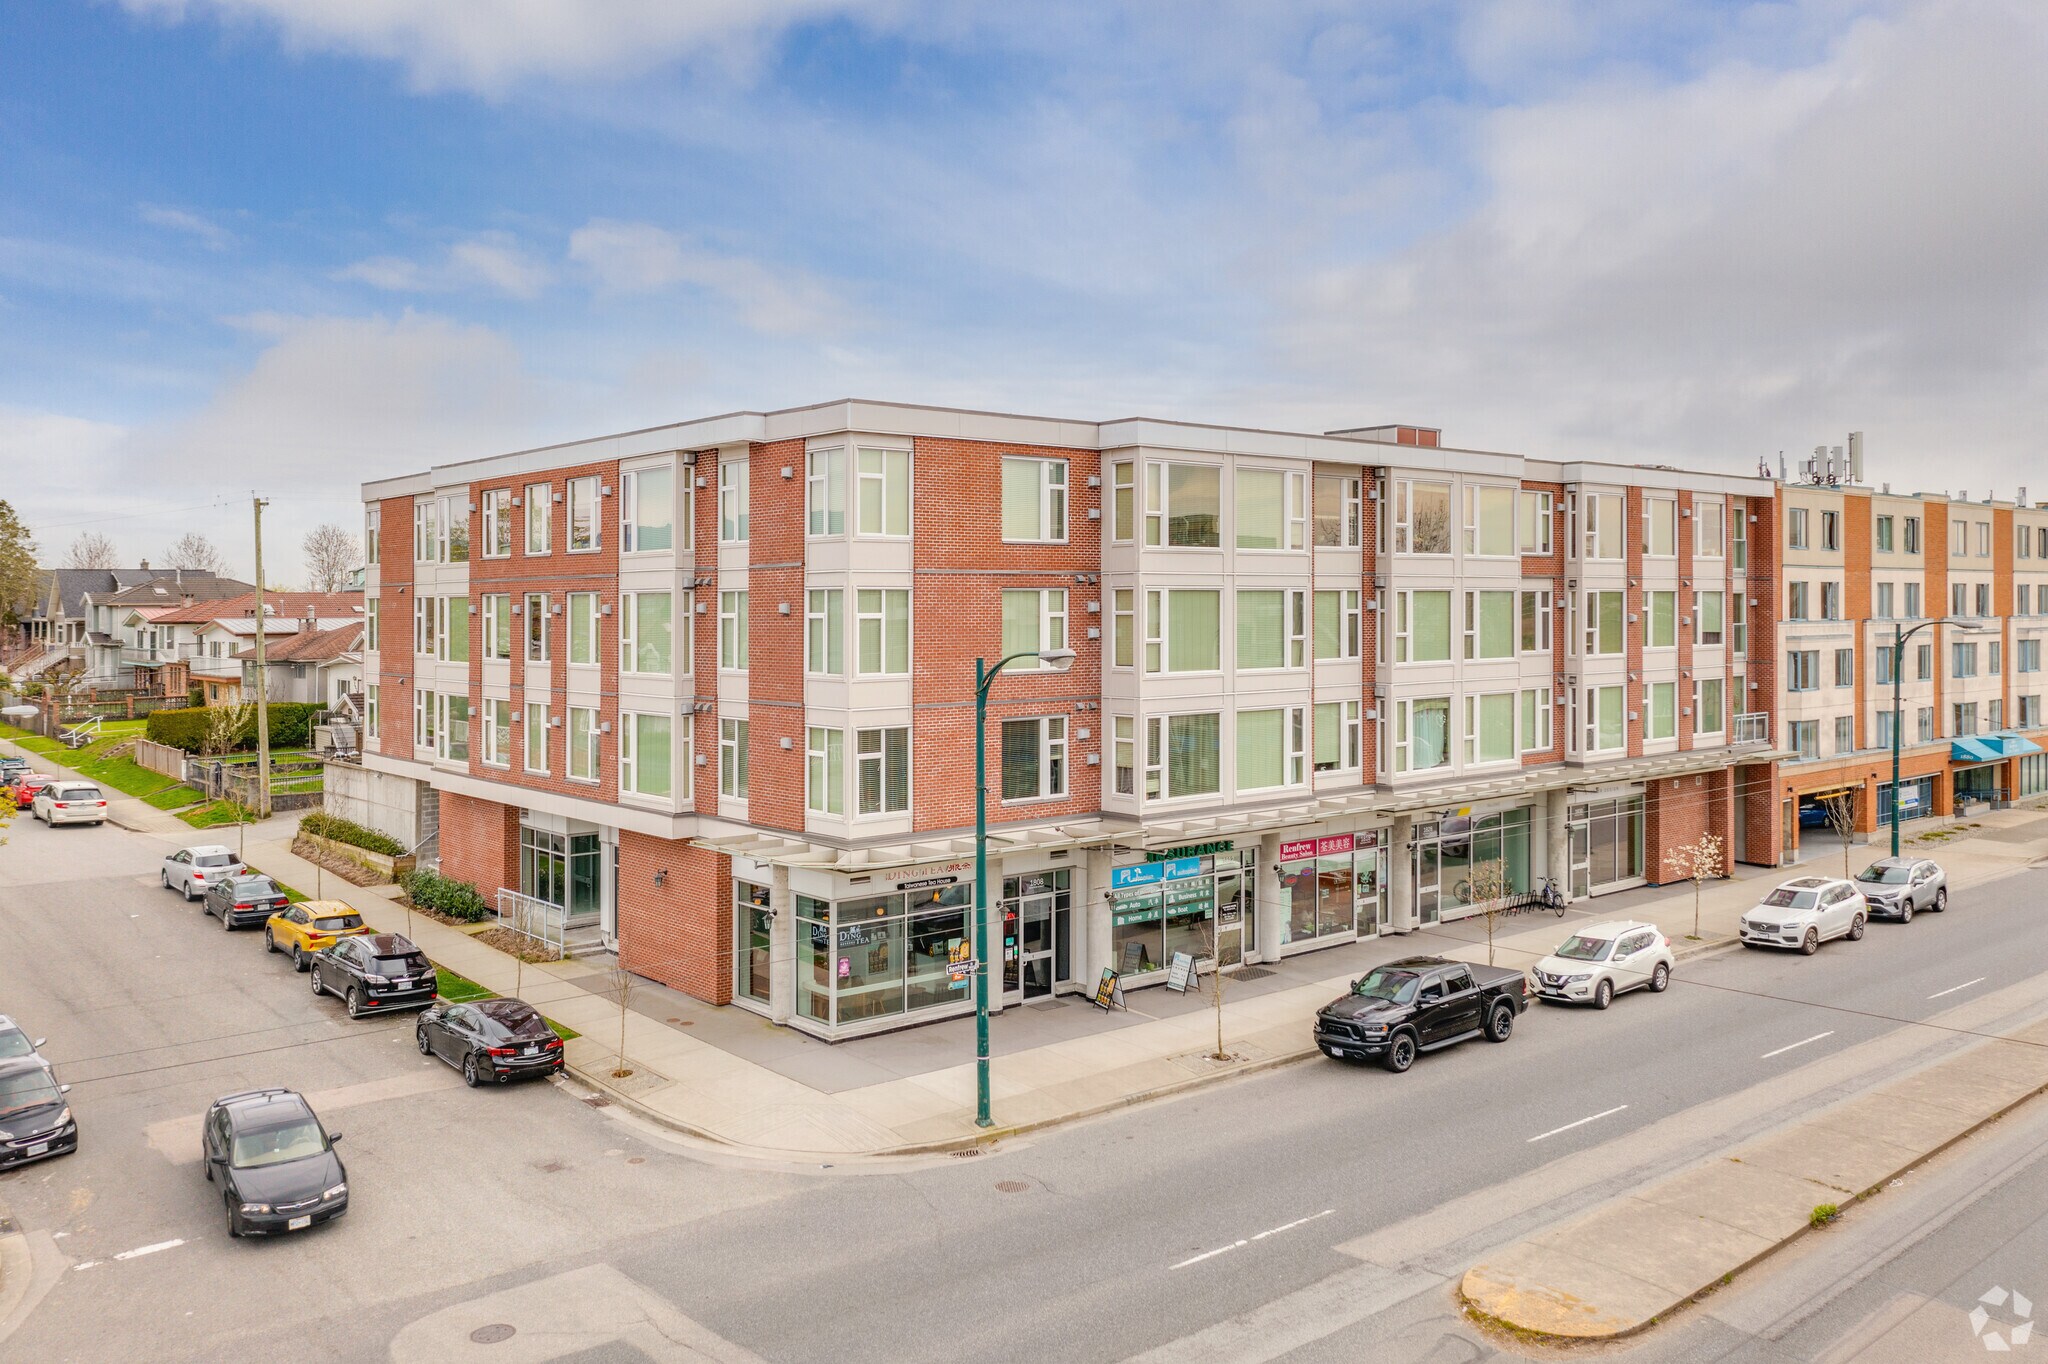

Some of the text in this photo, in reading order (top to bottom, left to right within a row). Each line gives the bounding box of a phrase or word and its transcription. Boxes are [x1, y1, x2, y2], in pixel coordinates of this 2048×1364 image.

[1146, 840, 1234, 863] INSURANCE
[1283, 843, 1311, 853] Renfrew
[904, 881, 928, 889] Taiwanese
[1029, 878, 1044, 887] 1808
[1178, 892, 1197, 900] Business
[1128, 914, 1142, 922] Home
[854, 937, 870, 945] TEA
[949, 964, 969, 972] Renfrew
